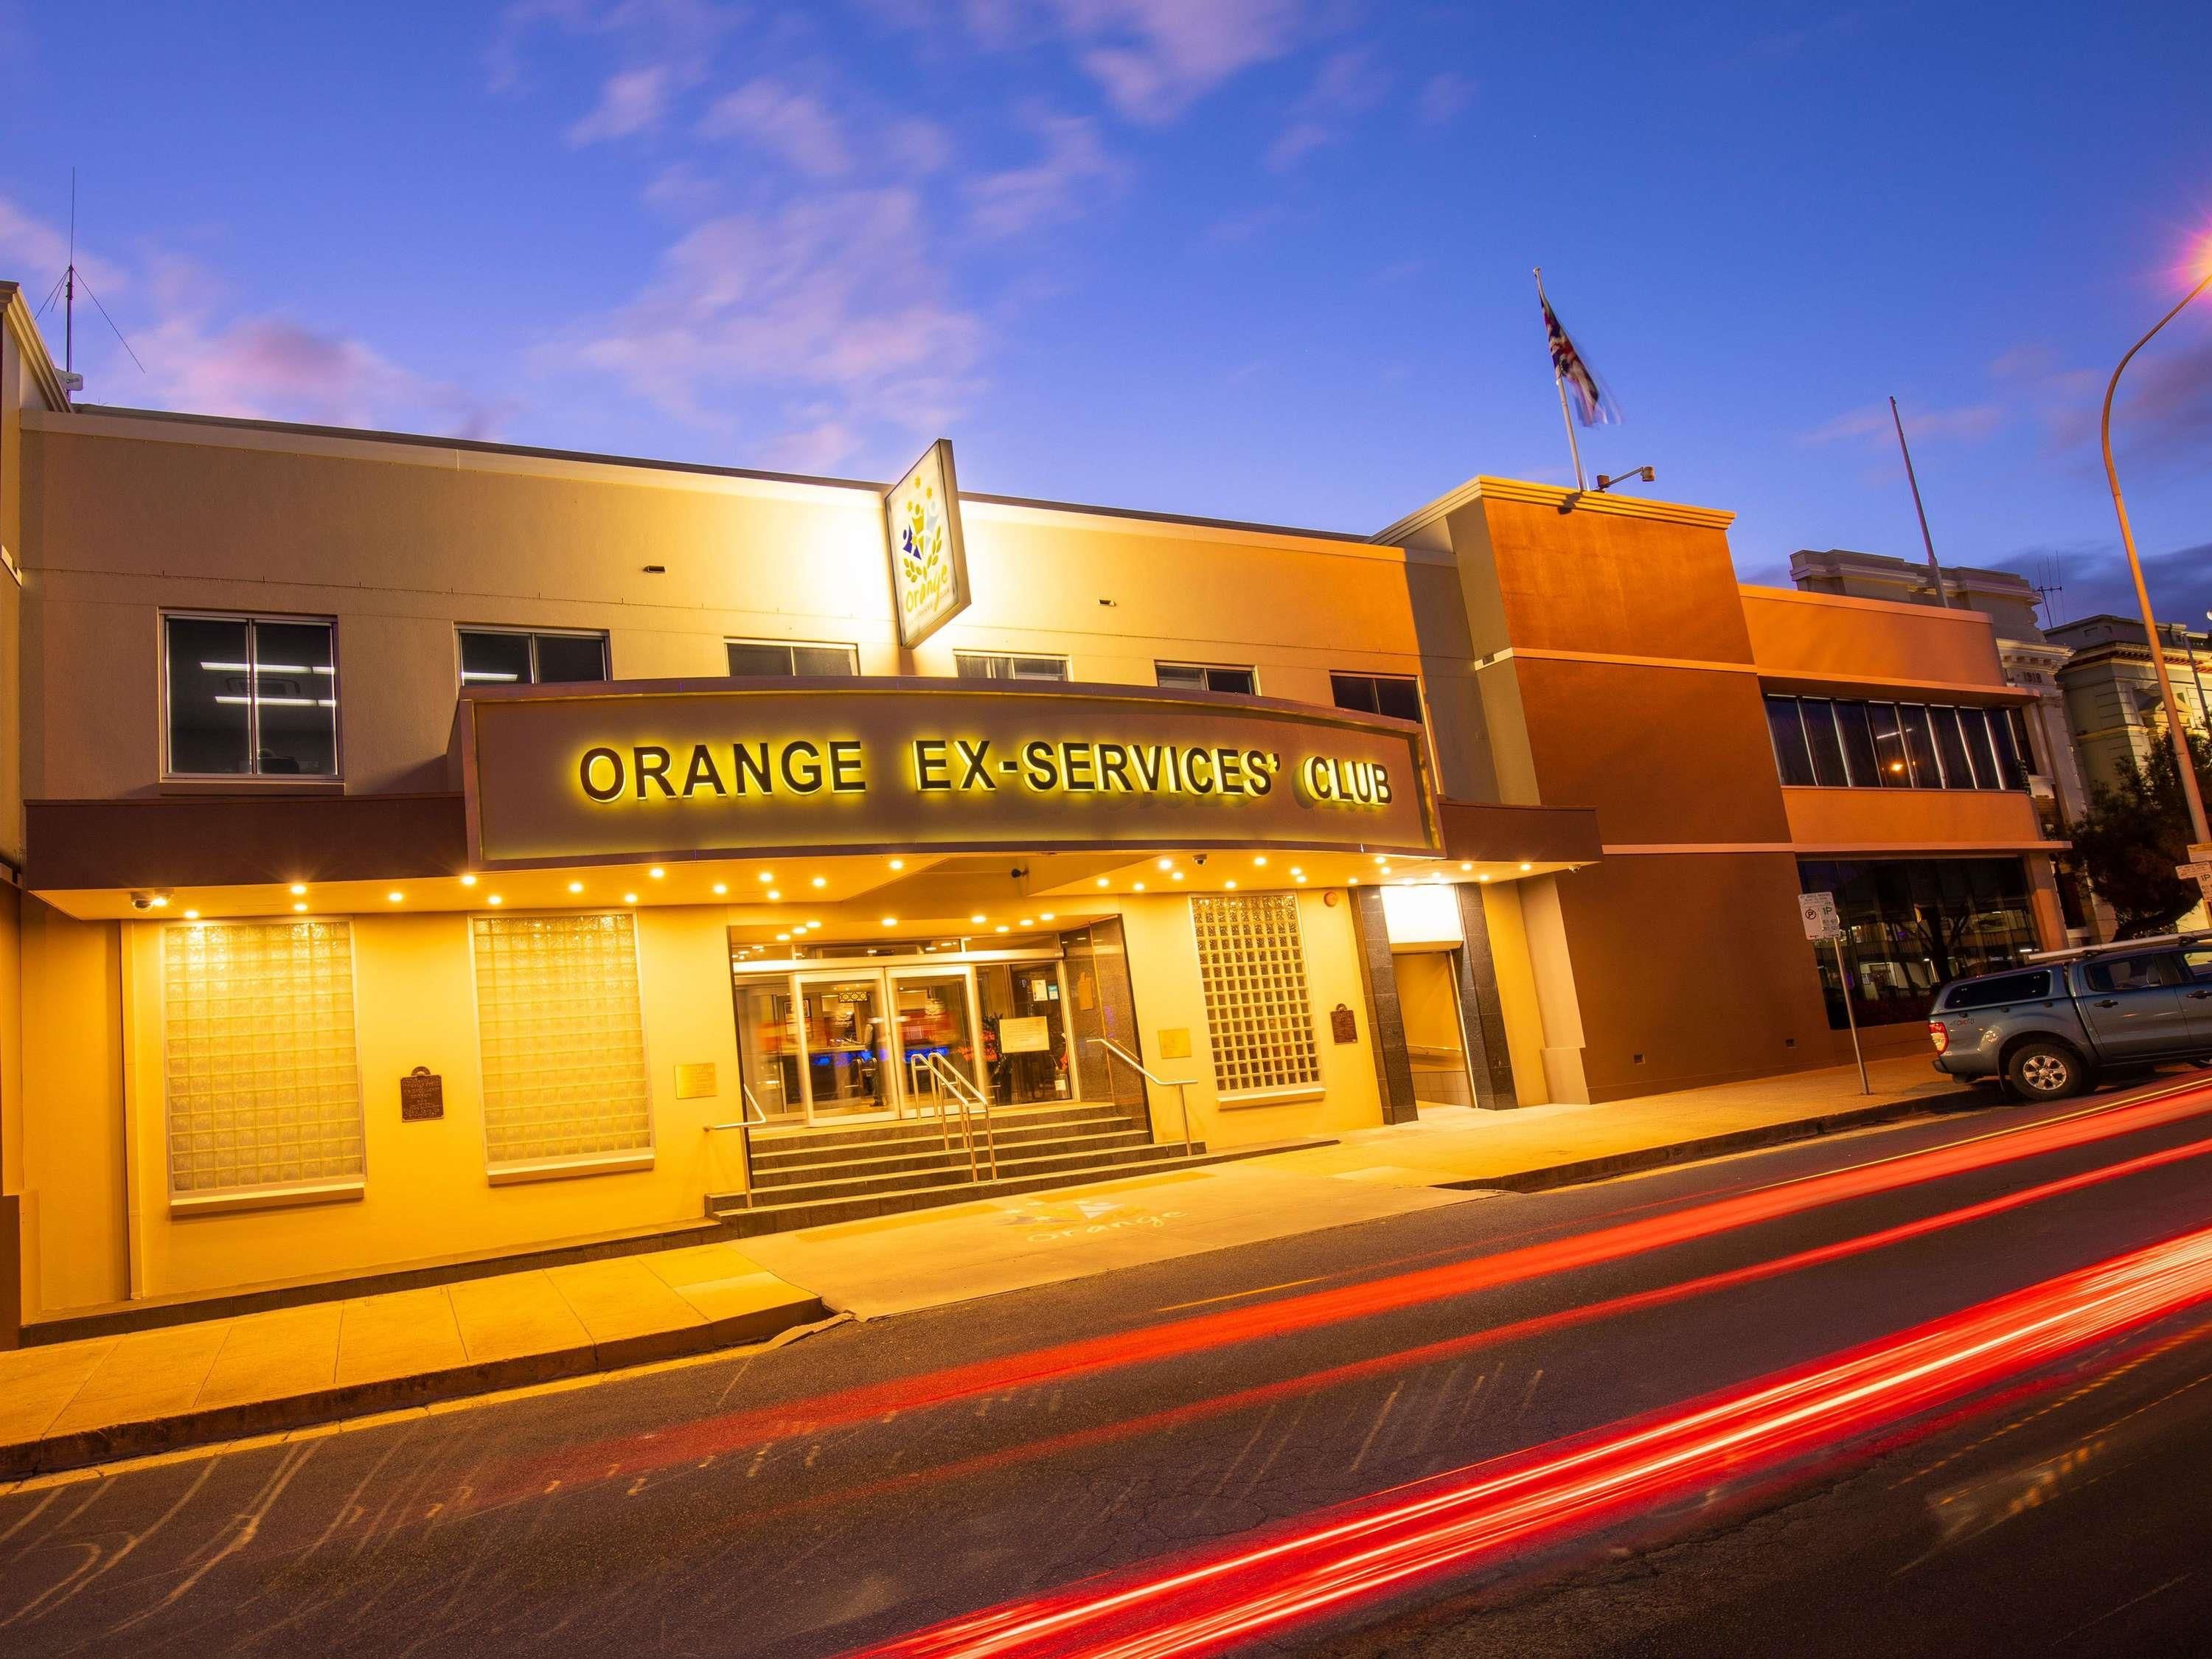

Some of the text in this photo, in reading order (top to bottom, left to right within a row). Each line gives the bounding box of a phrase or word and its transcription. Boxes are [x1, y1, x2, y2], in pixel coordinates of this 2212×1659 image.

[580, 740, 1393, 807] ORANGE EX-SERVICES' CLUB
[1026, 1211, 1189, 1242] orange
